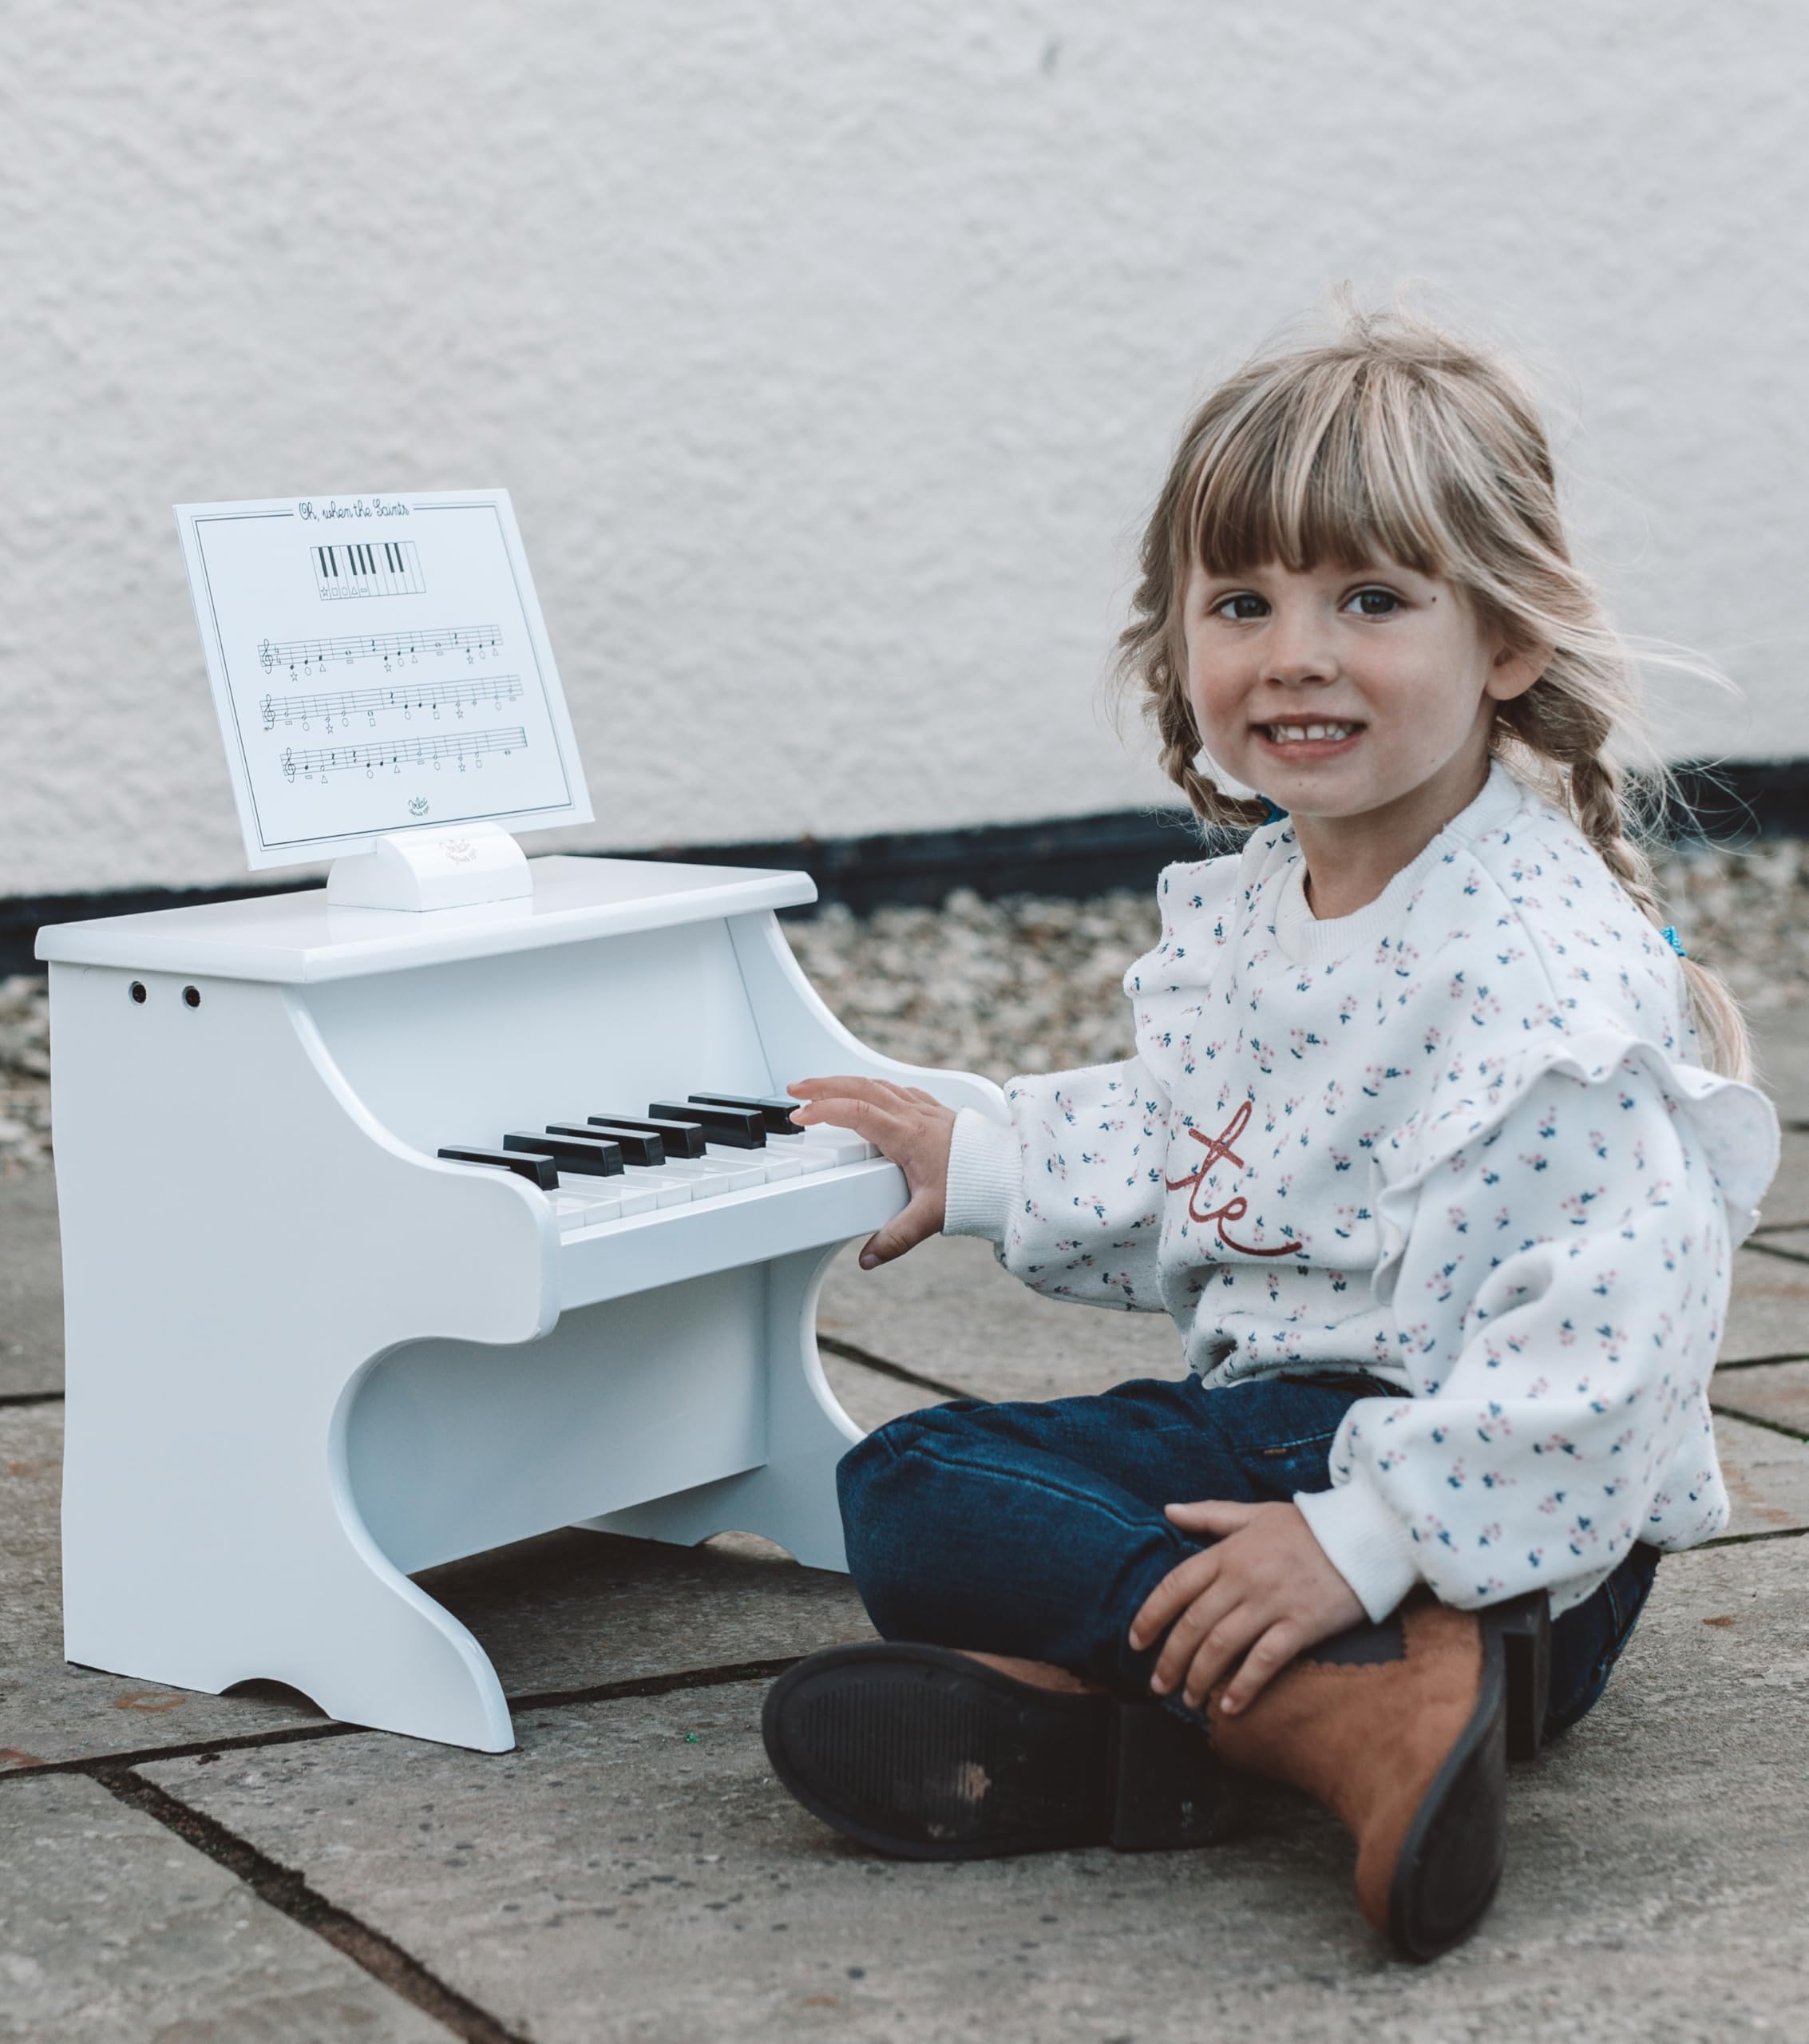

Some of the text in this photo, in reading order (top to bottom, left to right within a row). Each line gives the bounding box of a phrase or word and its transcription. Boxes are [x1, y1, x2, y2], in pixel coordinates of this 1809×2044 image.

[299, 498, 410, 522] Oh, when the Saints
